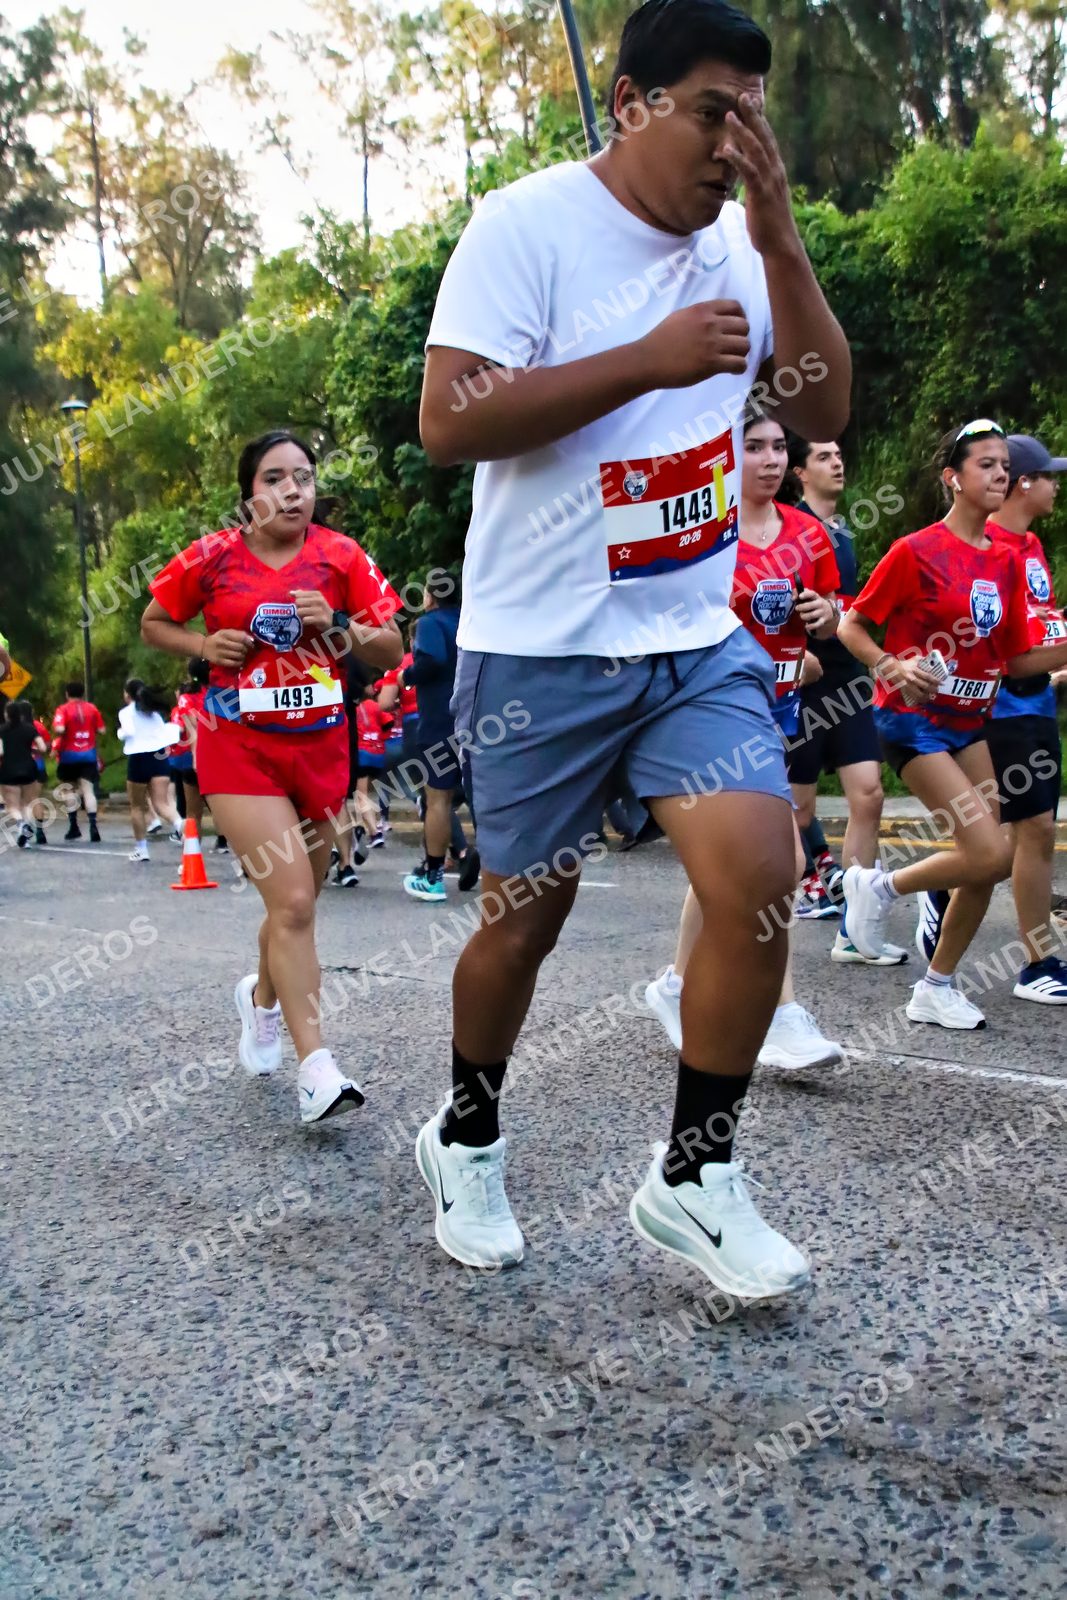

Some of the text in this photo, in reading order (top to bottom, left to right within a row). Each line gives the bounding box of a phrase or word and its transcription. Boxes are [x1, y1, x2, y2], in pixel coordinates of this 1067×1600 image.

[660, 486, 712, 533] 1443
[262, 608, 292, 616] BIMBO
[263, 617, 291, 627] Global
[272, 686, 313, 709] 1493
[951, 678, 987, 698] 17681
